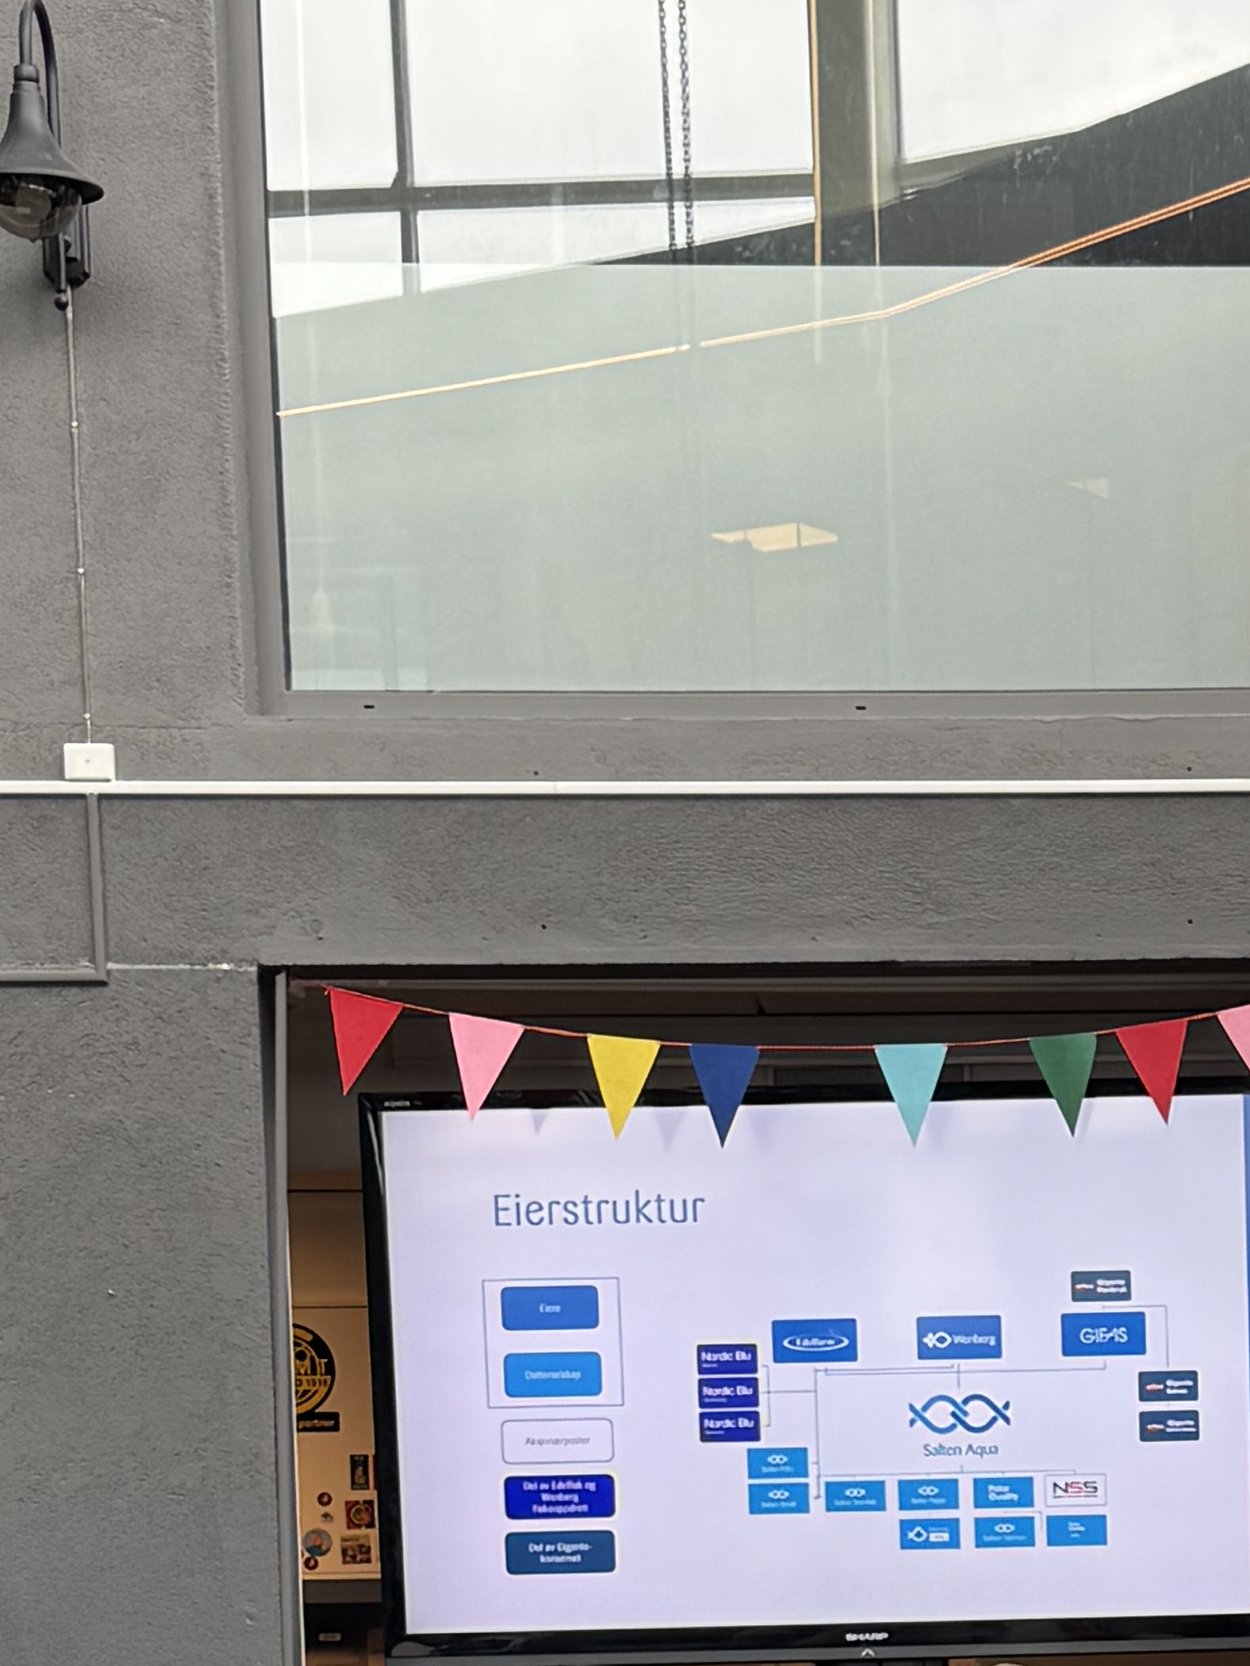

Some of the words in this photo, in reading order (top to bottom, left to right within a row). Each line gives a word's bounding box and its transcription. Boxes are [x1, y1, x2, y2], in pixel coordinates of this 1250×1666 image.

[494, 1189, 705, 1226] Eierstruktur
[923, 1442, 962, 1457] Salten
[965, 1443, 999, 1459] Aqua
[1052, 1480, 1099, 1495] NSS
